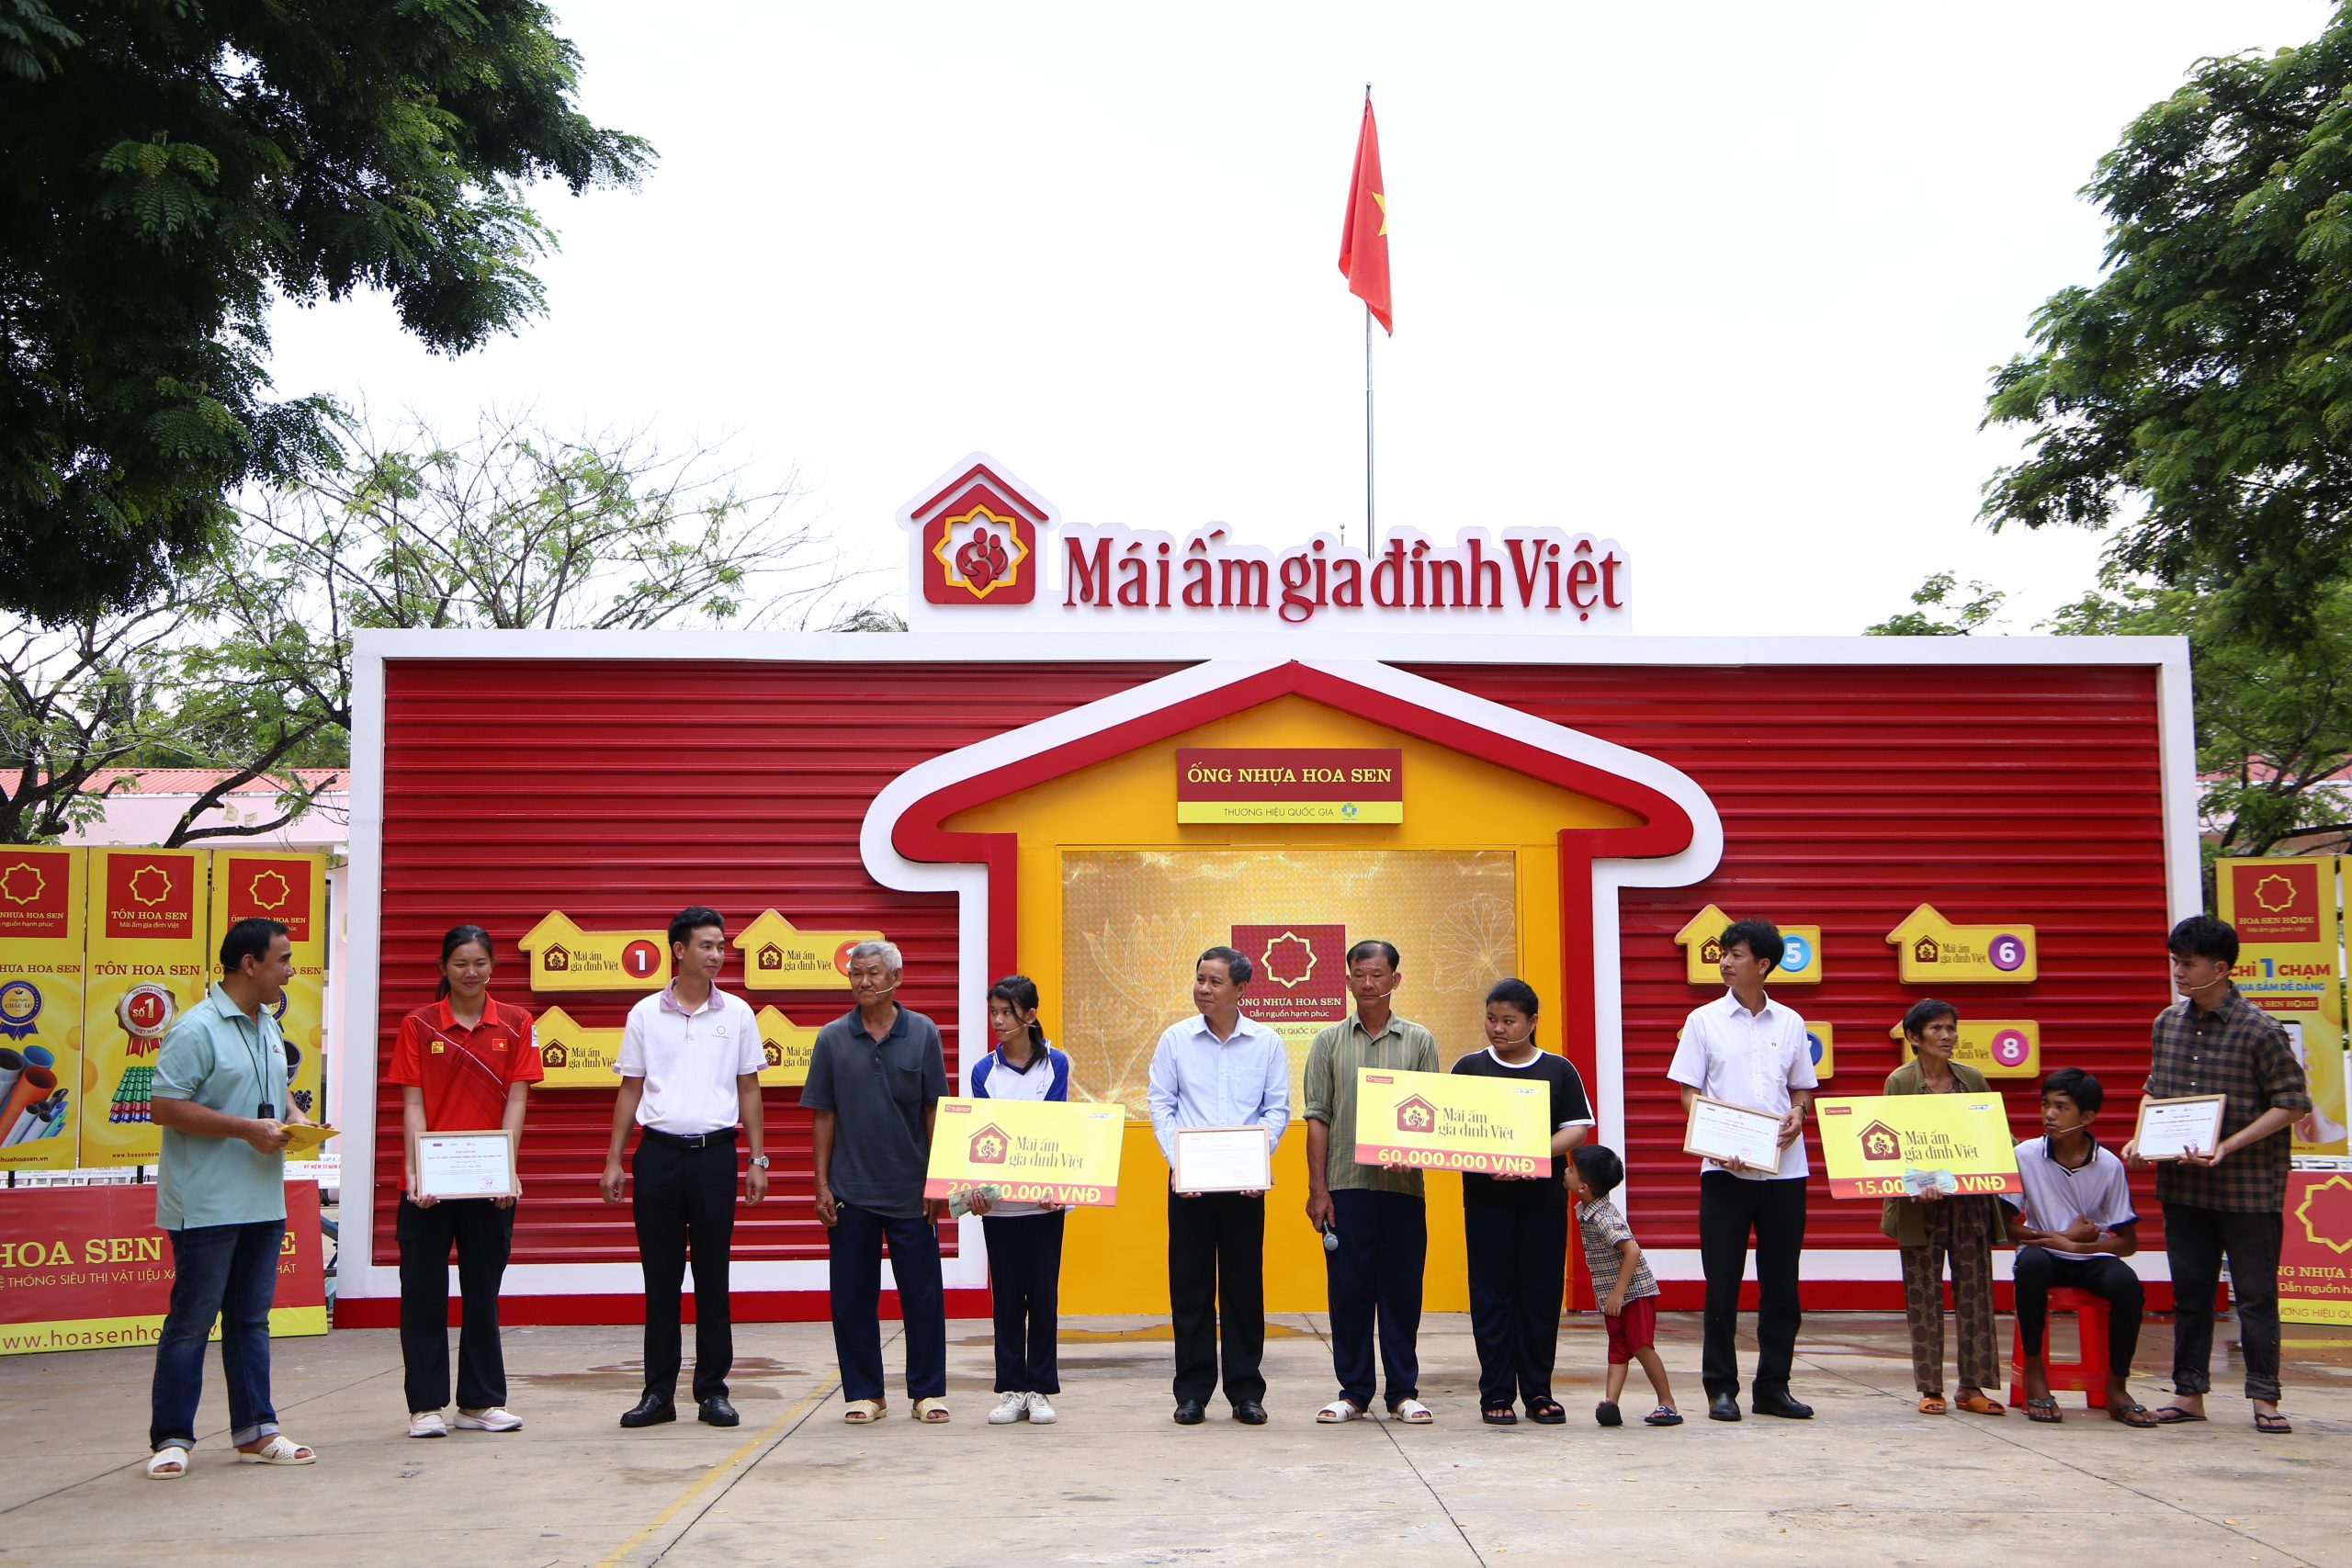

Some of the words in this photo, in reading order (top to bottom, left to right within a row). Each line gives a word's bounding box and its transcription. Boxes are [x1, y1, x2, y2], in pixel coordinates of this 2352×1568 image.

[1187, 761, 1233, 783] ỐNG
[1238, 767, 1296, 785] NHỰA
[1302, 768, 1346, 783] HOA
[1351, 768, 1392, 783] SEN
[1265, 807, 1285, 818] HIỆU
[1287, 807, 1316, 817] QUỐC
[1317, 808, 1334, 817] GIA
[111, 908, 135, 919] TÔN
[138, 911, 162, 919] HOA
[164, 912, 187, 920] SEN
[573, 951, 587, 962] Mái
[589, 950, 601, 961] ấm
[635, 949, 646, 971] 1
[786, 950, 801, 961] Mái
[802, 949, 815, 960] ấm
[1785, 942, 1802, 964] 5
[1998, 942, 2016, 964] 6
[28, 964, 53, 973] HOA
[57, 964, 81, 974] SEN
[95, 961, 128, 975] TÔN
[132, 964, 164, 975] HOA
[170, 964, 200, 976] SEN
[300, 966, 322, 975] SEN
[571, 963, 582, 973] gia
[604, 961, 618, 972] Việt
[784, 961, 796, 972] gia
[817, 960, 831, 971] Việt
[2259, 958, 2274, 978] 1
[2278, 964, 2330, 980] CHẠM
[145, 998, 154, 1019] 1
[1263, 997, 1293, 1009] NHỰA
[1295, 998, 1317, 1006] HOA
[1320, 998, 1341, 1006] SEN
[1250, 1009, 1264, 1018] Dẫn
[1266, 1010, 1289, 1019] nguồn
[1291, 1010, 1309, 1019] hạnh
[1311, 1010, 1329, 1018] phúc
[571, 1046, 586, 1057] Mái
[587, 1046, 600, 1057] ấm
[786, 1045, 800, 1056] Mái
[2002, 1037, 2019, 1059] 8
[569, 1058, 581, 1069] gia
[783, 1057, 795, 1069] gia
[1443, 1108, 1464, 1122] Mái
[1468, 1110, 1487, 1124] ấm
[1438, 1123, 1456, 1138] gia
[1490, 1124, 1514, 1143] Việt
[1905, 1131, 1928, 1145] Mái
[1930, 1129, 1950, 1145] ấm
[1015, 1135, 1036, 1152] Mái
[1040, 1137, 1059, 1153] ấm
[1008, 1153, 1026, 1169] gia
[1061, 1153, 1083, 1170] Việt
[1378, 1149, 1487, 1169] 60.000.000
[1491, 1156, 1536, 1174] VNĐ
[1904, 1146, 1923, 1165] gia
[1954, 1144, 1980, 1161] Việt
[1961, 1175, 2006, 1192] VNĐ
[1058, 1186, 1102, 1203] VNĐ
[85, 1236, 164, 1264] SEN
[8, 1273, 56, 1287] THỐNG
[60, 1272, 85, 1285] SIÊU
[89, 1272, 107, 1284] THỊ
[111, 1269, 134, 1284] VẬT
[138, 1268, 160, 1282] LIỆU
[2299, 1267, 2346, 1280] NHỰA
[2278, 1280, 2301, 1292] Dẫn
[2304, 1283, 2340, 1294] nguồn
[2312, 1307, 2335, 1318] HIỆU
